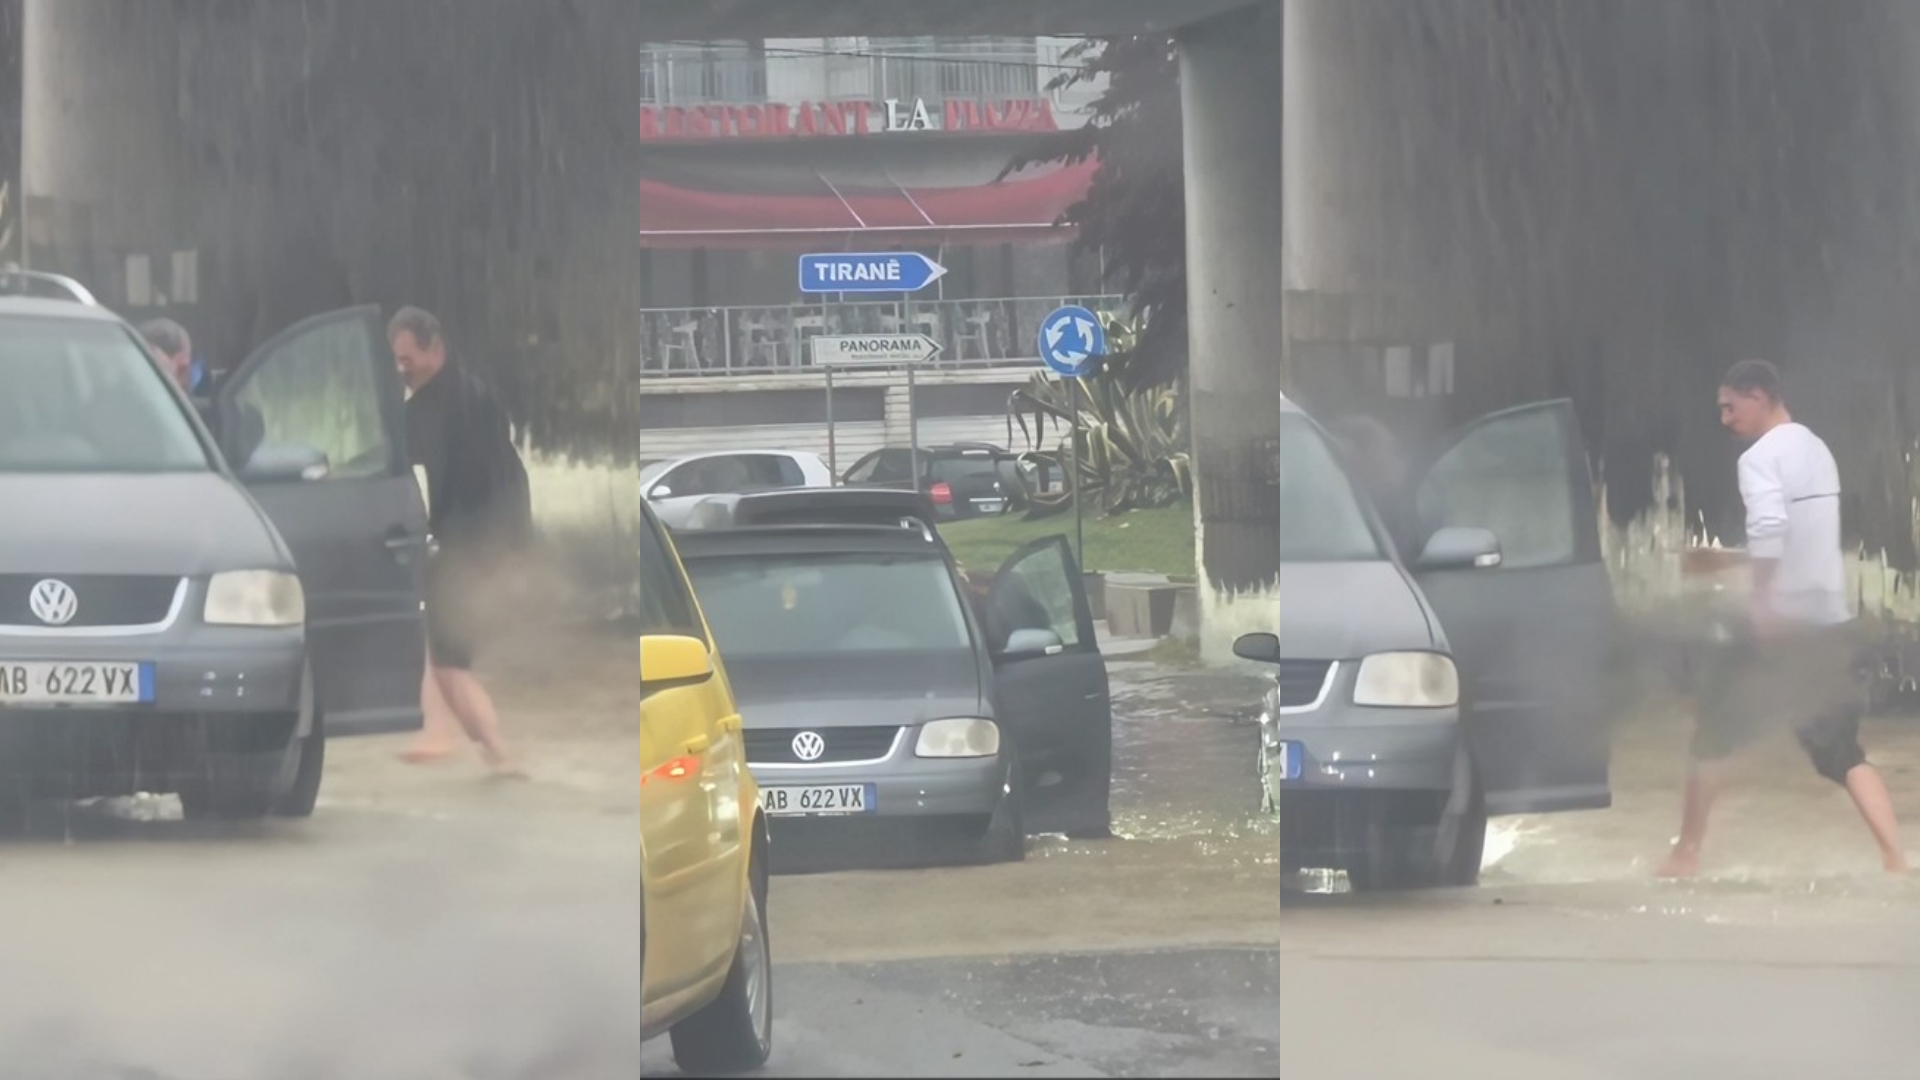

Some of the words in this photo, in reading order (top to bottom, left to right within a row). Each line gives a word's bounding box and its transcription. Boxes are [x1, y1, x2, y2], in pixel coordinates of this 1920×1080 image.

[885, 97, 933, 131] LA
[814, 259, 901, 281] TIRANË
[840, 339, 922, 352] PANORAMA
[46, 665, 96, 695] 622
[103, 665, 135, 695] VX
[765, 789, 788, 810] AB
[800, 788, 835, 809] 622
[839, 786, 862, 808] VX
